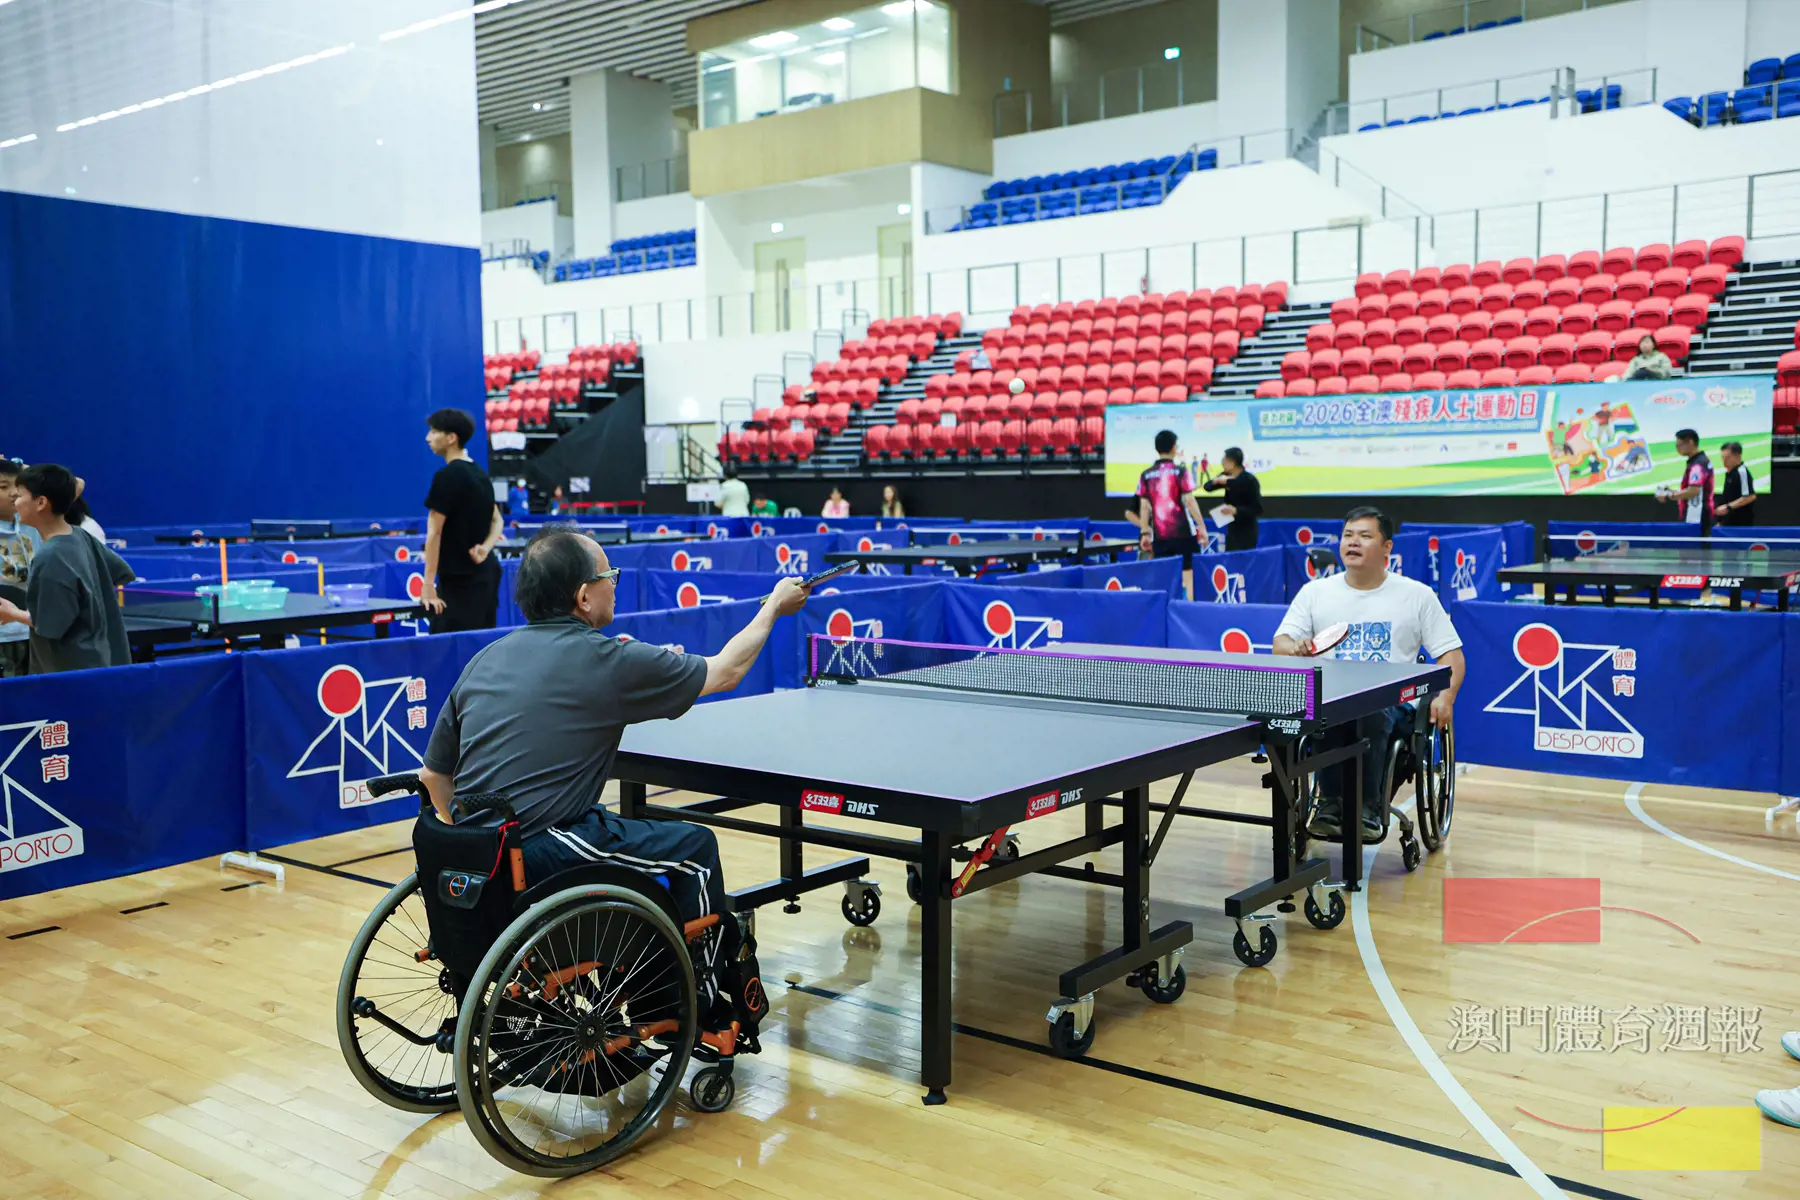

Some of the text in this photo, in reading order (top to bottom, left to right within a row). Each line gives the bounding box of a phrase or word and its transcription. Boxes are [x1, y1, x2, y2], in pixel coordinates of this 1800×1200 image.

[1709, 577, 1744, 588] DHS
[1613, 650, 1634, 695] 體育
[41, 722, 69, 781] 體育
[1537, 731, 1636, 754] DESPORTO
[1060, 787, 1084, 805] DHS
[846, 800, 879, 816] DHS
